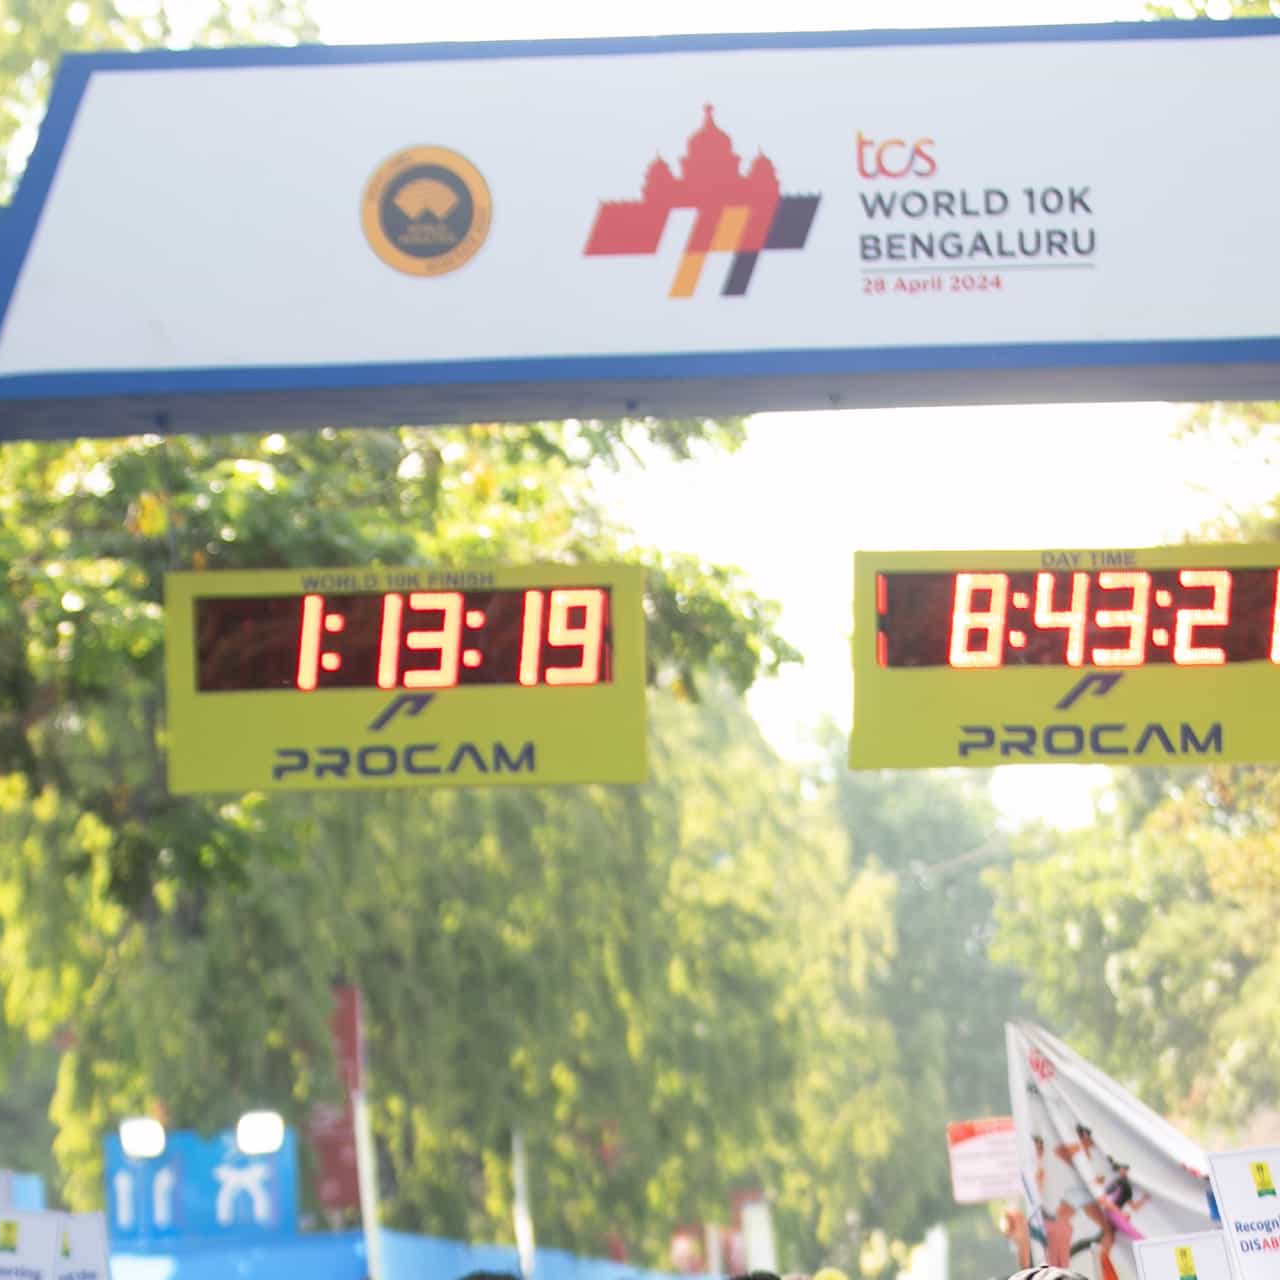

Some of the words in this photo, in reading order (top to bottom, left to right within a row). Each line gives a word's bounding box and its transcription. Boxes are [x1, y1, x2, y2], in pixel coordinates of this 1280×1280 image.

[856, 129, 938, 179] tcs
[858, 188, 1009, 220] WORLD
[1023, 186, 1092, 215] 10K
[859, 228, 1096, 261] BENGALURU
[863, 277, 886, 294] 28
[893, 275, 942, 296] April
[951, 274, 1003, 291] 2024
[1041, 551, 1082, 568] DAY
[1087, 550, 1137, 567] TIME
[957, 721, 1225, 759] PROCAM
[272, 740, 538, 782] PROCAM
